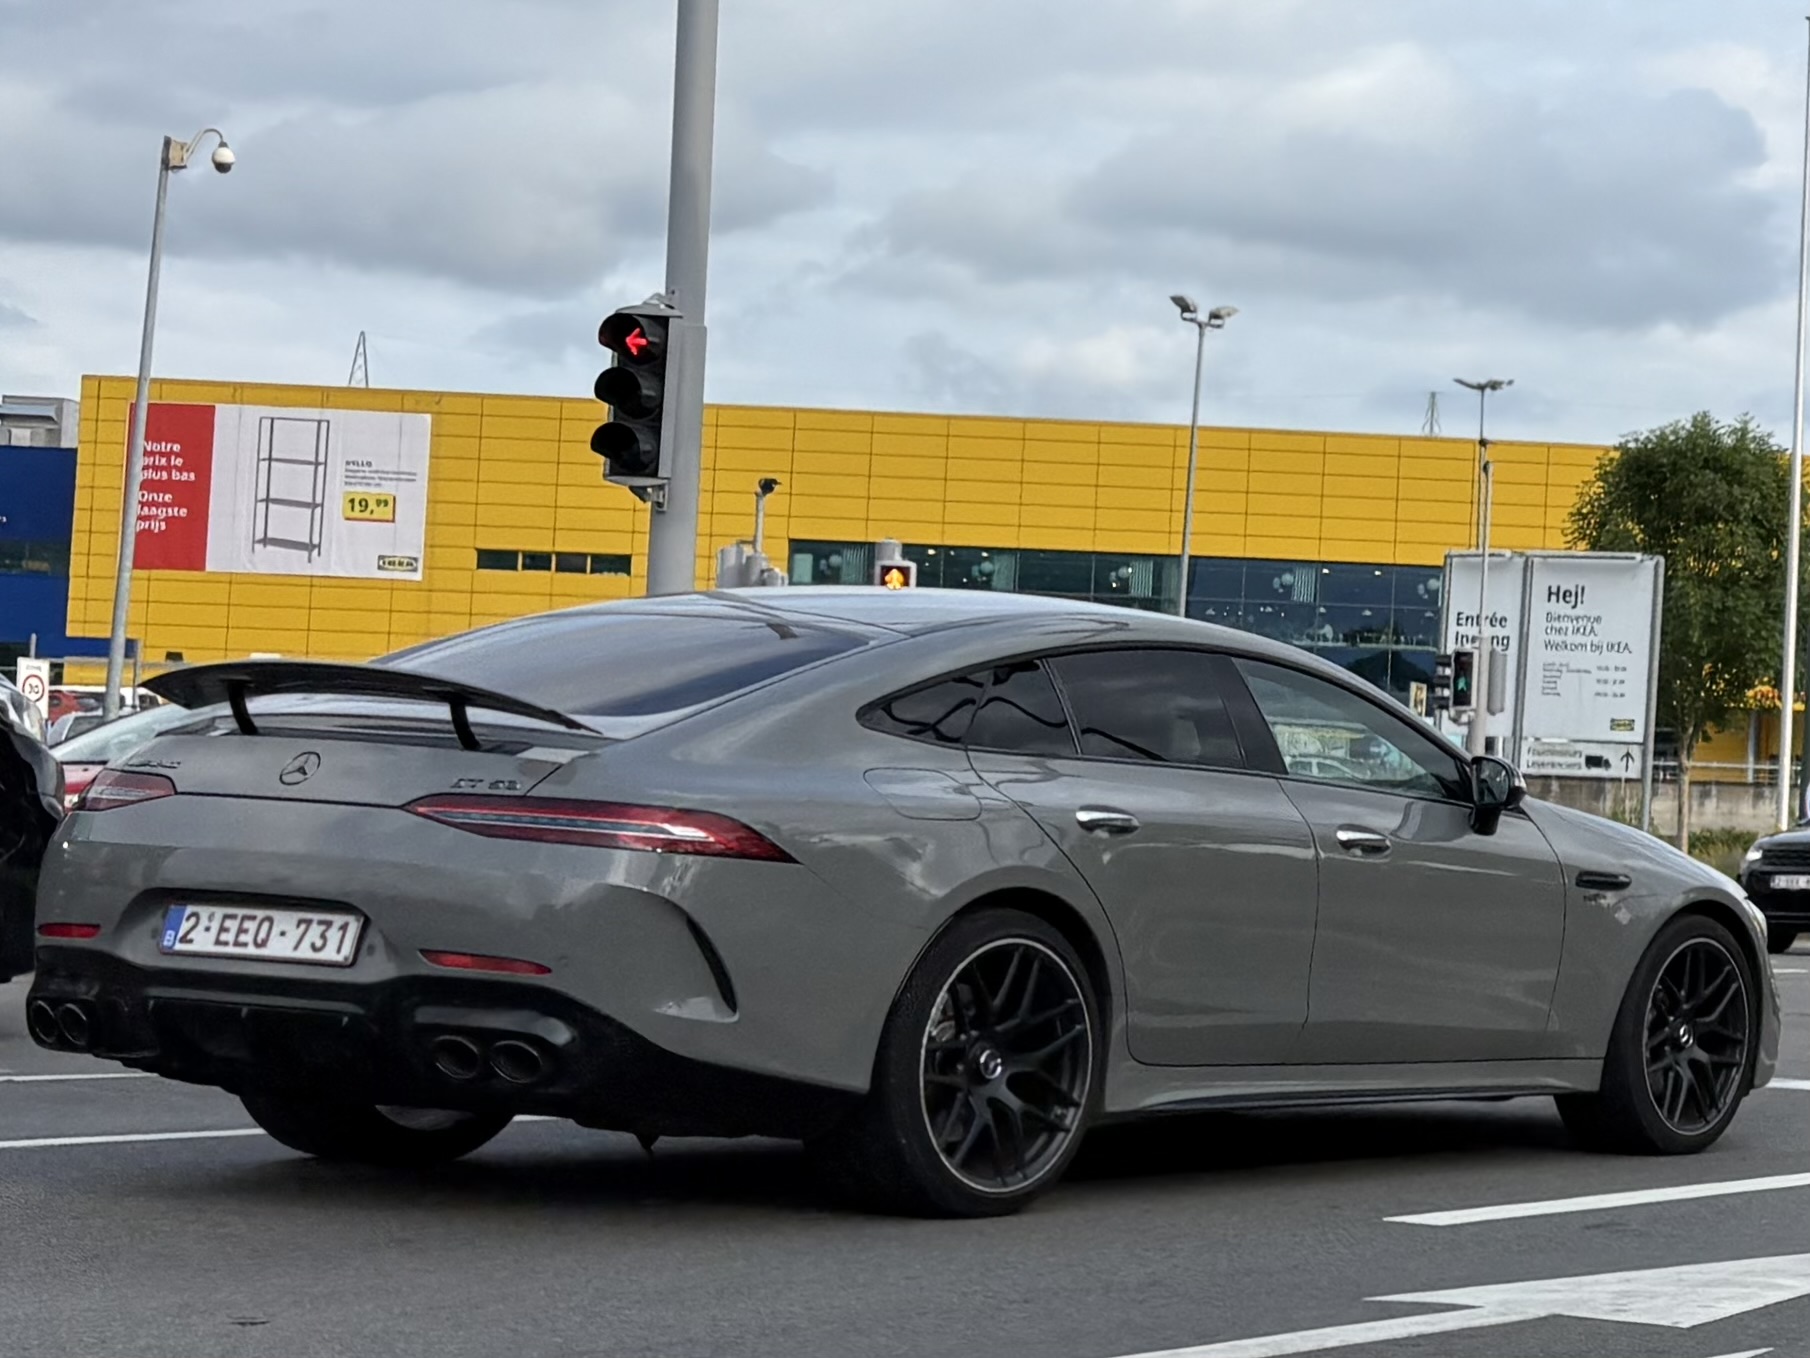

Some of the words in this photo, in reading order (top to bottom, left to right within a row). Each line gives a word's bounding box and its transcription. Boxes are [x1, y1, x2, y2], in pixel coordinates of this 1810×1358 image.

[144, 440, 181, 453] Notre
[170, 454, 184, 467] le
[171, 469, 196, 482] bas
[138, 490, 173, 502] Onze
[136, 503, 188, 520] laagste
[135, 519, 167, 533] prijs
[1547, 584, 1586, 609] Hej!
[1544, 624, 1569, 637] chez
[1543, 638, 1588, 653] Welkom
[1590, 639, 1604, 656] bij
[162, 929, 176, 947] B
